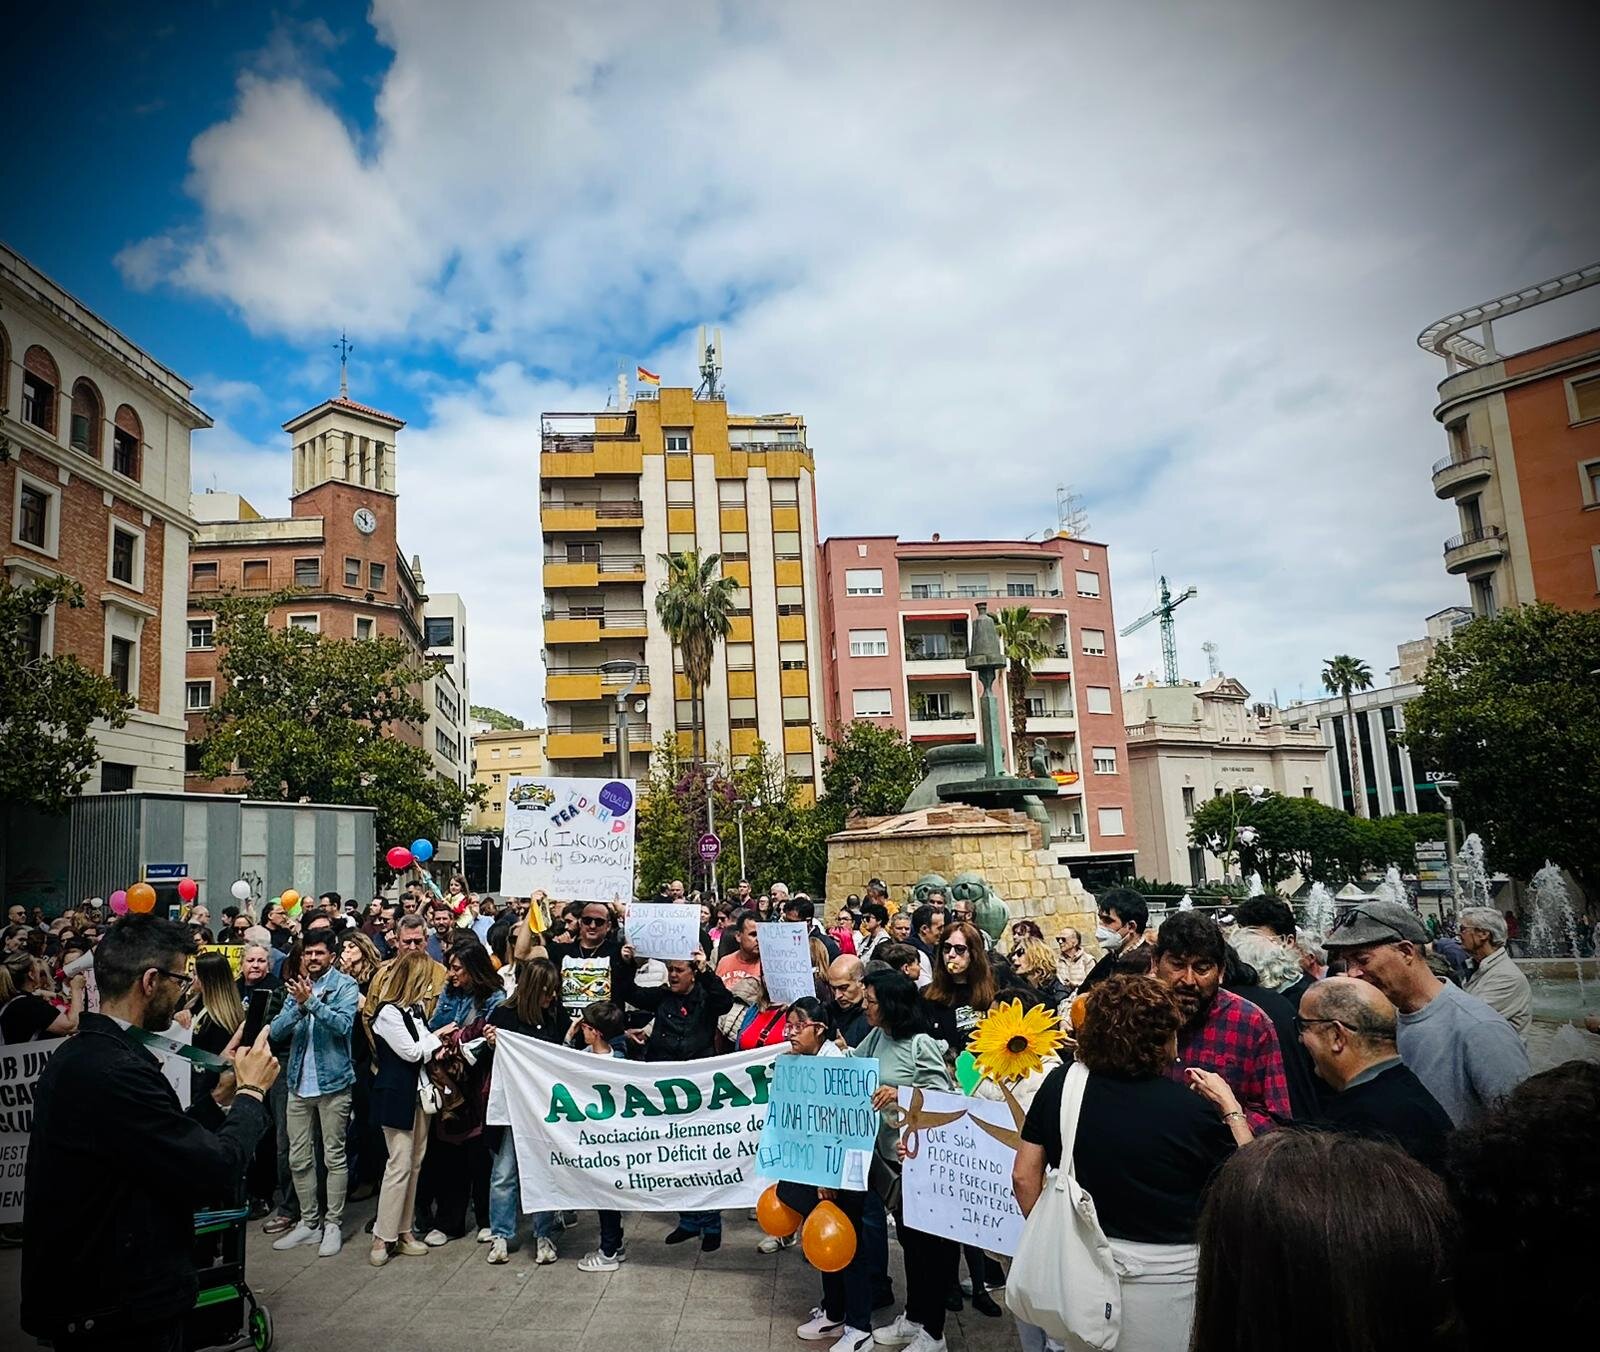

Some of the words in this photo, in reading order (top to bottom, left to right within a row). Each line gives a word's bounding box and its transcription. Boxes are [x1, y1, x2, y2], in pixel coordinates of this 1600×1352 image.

[551, 804, 580, 827] TEA
[520, 854, 538, 866] NO
[701, 844, 718, 852] STOP
[823, 1067, 877, 1097] DERECHO
[579, 1126, 661, 1146] Asociación
[664, 1120, 742, 1140] Jiennense
[747, 1114, 764, 1132] de
[767, 1101, 777, 1127] A
[781, 1102, 802, 1129] UNA
[808, 1100, 877, 1137] FORMACIÓN
[953, 1134, 977, 1149] SIGA
[549, 1149, 620, 1168] Afectados
[626, 1153, 652, 1170] por
[657, 1142, 709, 1164] Déficit
[712, 1141, 732, 1160] de
[782, 1141, 815, 1170] COMO
[823, 1140, 843, 1175] TÚ
[928, 1146, 1003, 1175] FLORECIENDO
[615, 1180, 624, 1190] e
[629, 1167, 744, 1192] Hiperactividad
[962, 1207, 1005, 1228] JAEN
